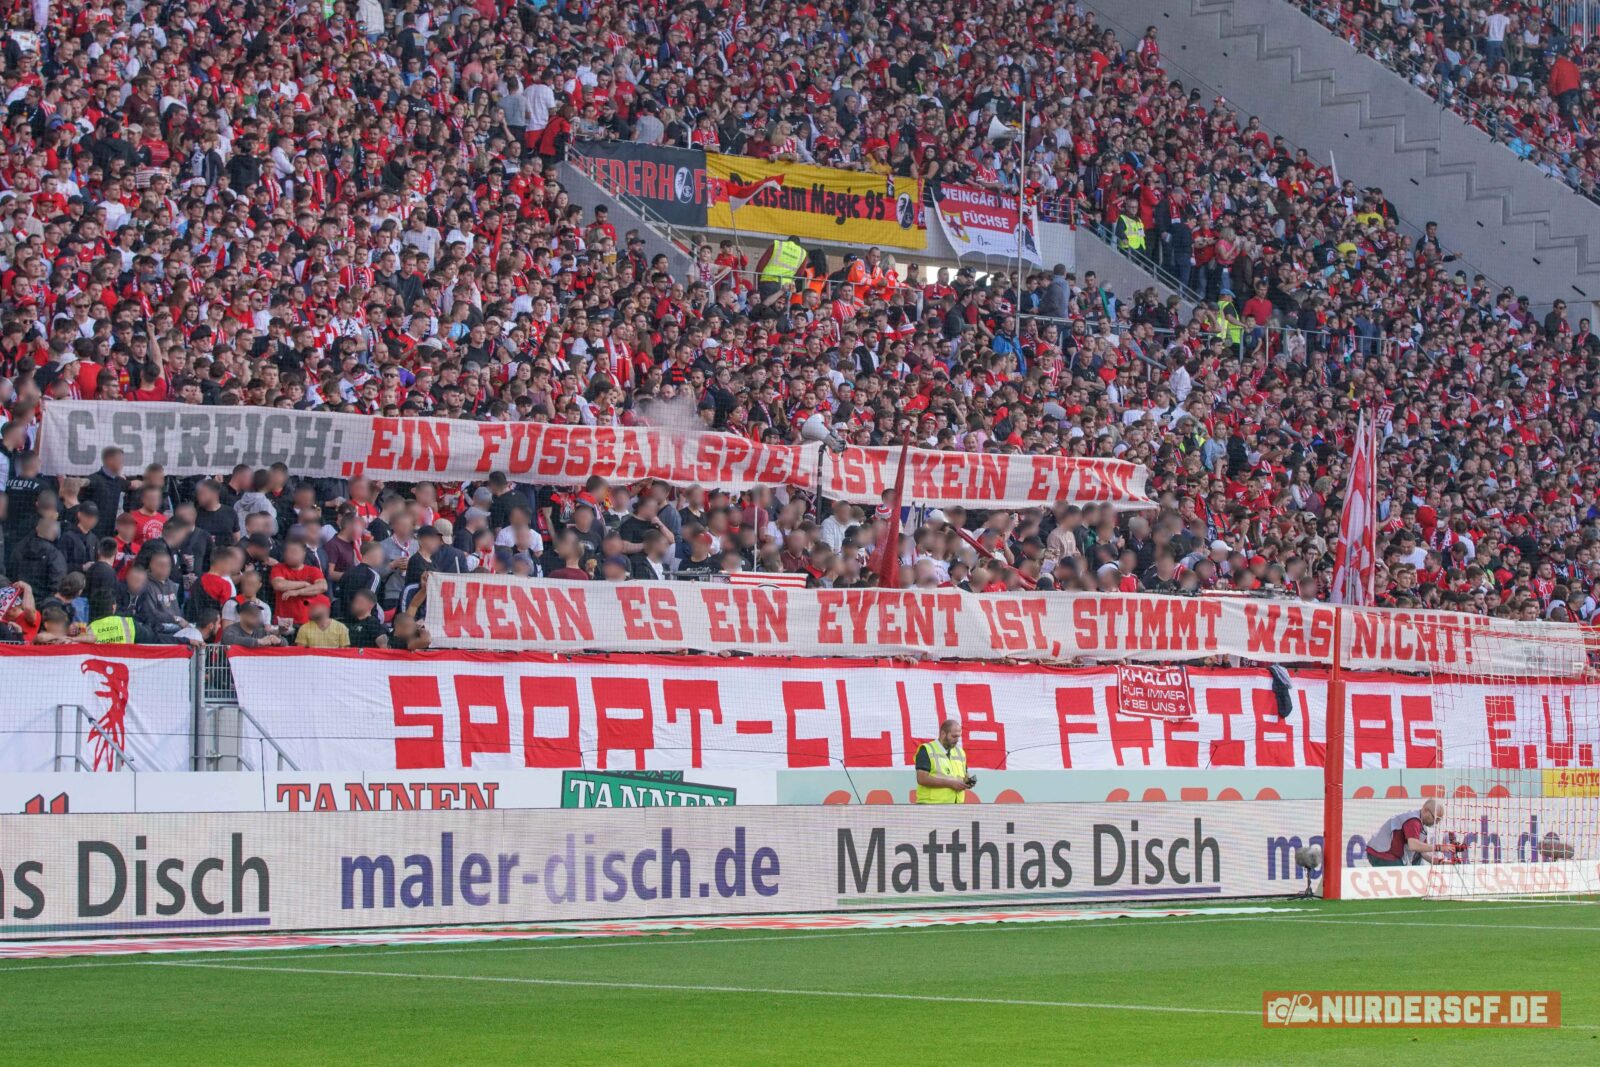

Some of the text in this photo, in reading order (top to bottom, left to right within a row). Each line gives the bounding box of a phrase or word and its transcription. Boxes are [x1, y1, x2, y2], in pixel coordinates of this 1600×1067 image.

[811, 183, 860, 225] Magic
[865, 190, 885, 220] 95
[962, 210, 1010, 229] FÜCHSE
[112, 411, 343, 470] STREICH:
[475, 422, 810, 488] FUSSBALLSPIEL
[828, 448, 889, 496] IST
[911, 452, 1010, 500] KEIN
[440, 581, 596, 641] WENN
[615, 586, 684, 641] ES
[701, 588, 789, 643] EIN
[816, 589, 963, 647] EVENT
[979, 598, 1061, 658] IST,
[1072, 598, 1222, 652] STIMMT
[1243, 603, 1334, 658] WAS
[1121, 668, 1182, 686] KHALID
[1123, 684, 1185, 700] FÜR IMMER
[1132, 699, 1176, 713] BEI UNS
[389, 674, 1007, 770] SPORT-CLUB
[1055, 685, 1443, 769] FREIBURG
[77, 832, 270, 918] Disch
[341, 826, 780, 910] maler-disch.de
[836, 820, 1073, 895] Matthias
[1092, 817, 1221, 887] Disch
[1350, 870, 1447, 897] CAZOO
